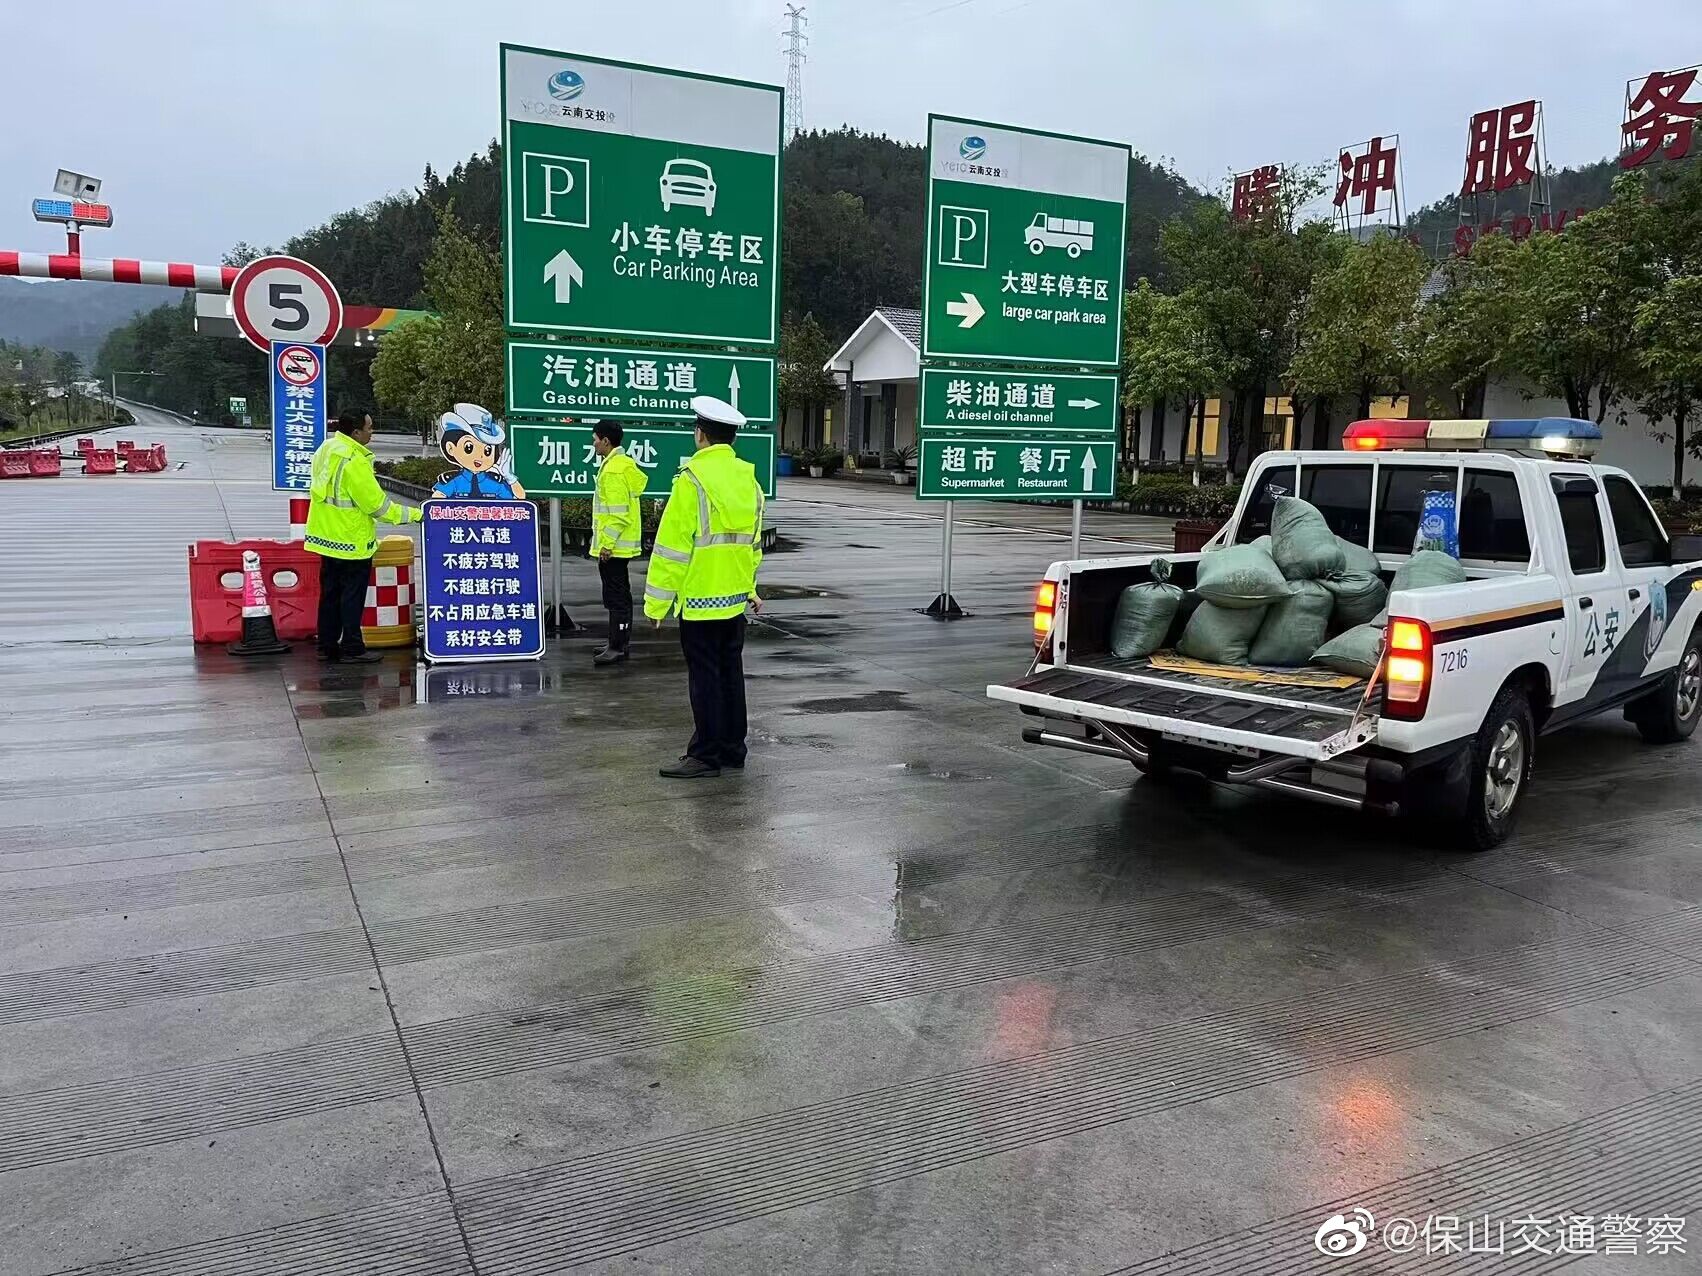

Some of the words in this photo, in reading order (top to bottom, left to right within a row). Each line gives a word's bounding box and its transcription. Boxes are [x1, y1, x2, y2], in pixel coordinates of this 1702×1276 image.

[540, 163, 574, 218] P
[611, 222, 764, 264] 小车停车区
[951, 214, 977, 261] P
[613, 256, 645, 277] Car
[651, 259, 715, 288] Parking
[720, 265, 759, 288] Area
[1001, 270, 1109, 301] 大型车停车区
[269, 283, 310, 331] 5
[1002, 302, 1033, 321] large
[1034, 307, 1052, 319] car
[1055, 308, 1080, 324] park
[1082, 312, 1106, 324] area
[543, 354, 698, 393] 汽油通道
[543, 390, 620, 406] Gasoline
[629, 394, 694, 410] channel
[946, 380, 1056, 409] 柴油通道
[946, 409, 955, 420] A
[957, 410, 991, 421] diesel
[994, 411, 1007, 422] oil
[1010, 412, 1053, 423] channel
[285, 385, 315, 488] 禁止大型车辆通行
[941, 446, 996, 473] 超市
[1019, 447, 1071, 473] 餐厅
[551, 469, 588, 485] Add
[941, 477, 1005, 489] Supermarket
[1018, 477, 1068, 488] Restaurant
[449, 527, 511, 544] 进入高速
[443, 552, 519, 570] 不疲劳驾驶
[443, 578, 520, 595] 不超速行驶
[429, 603, 537, 621] 不占用应急车道
[445, 628, 522, 647] 系好安全带
[1583, 606, 1619, 658] 公安
[1441, 648, 1468, 673] 7216
